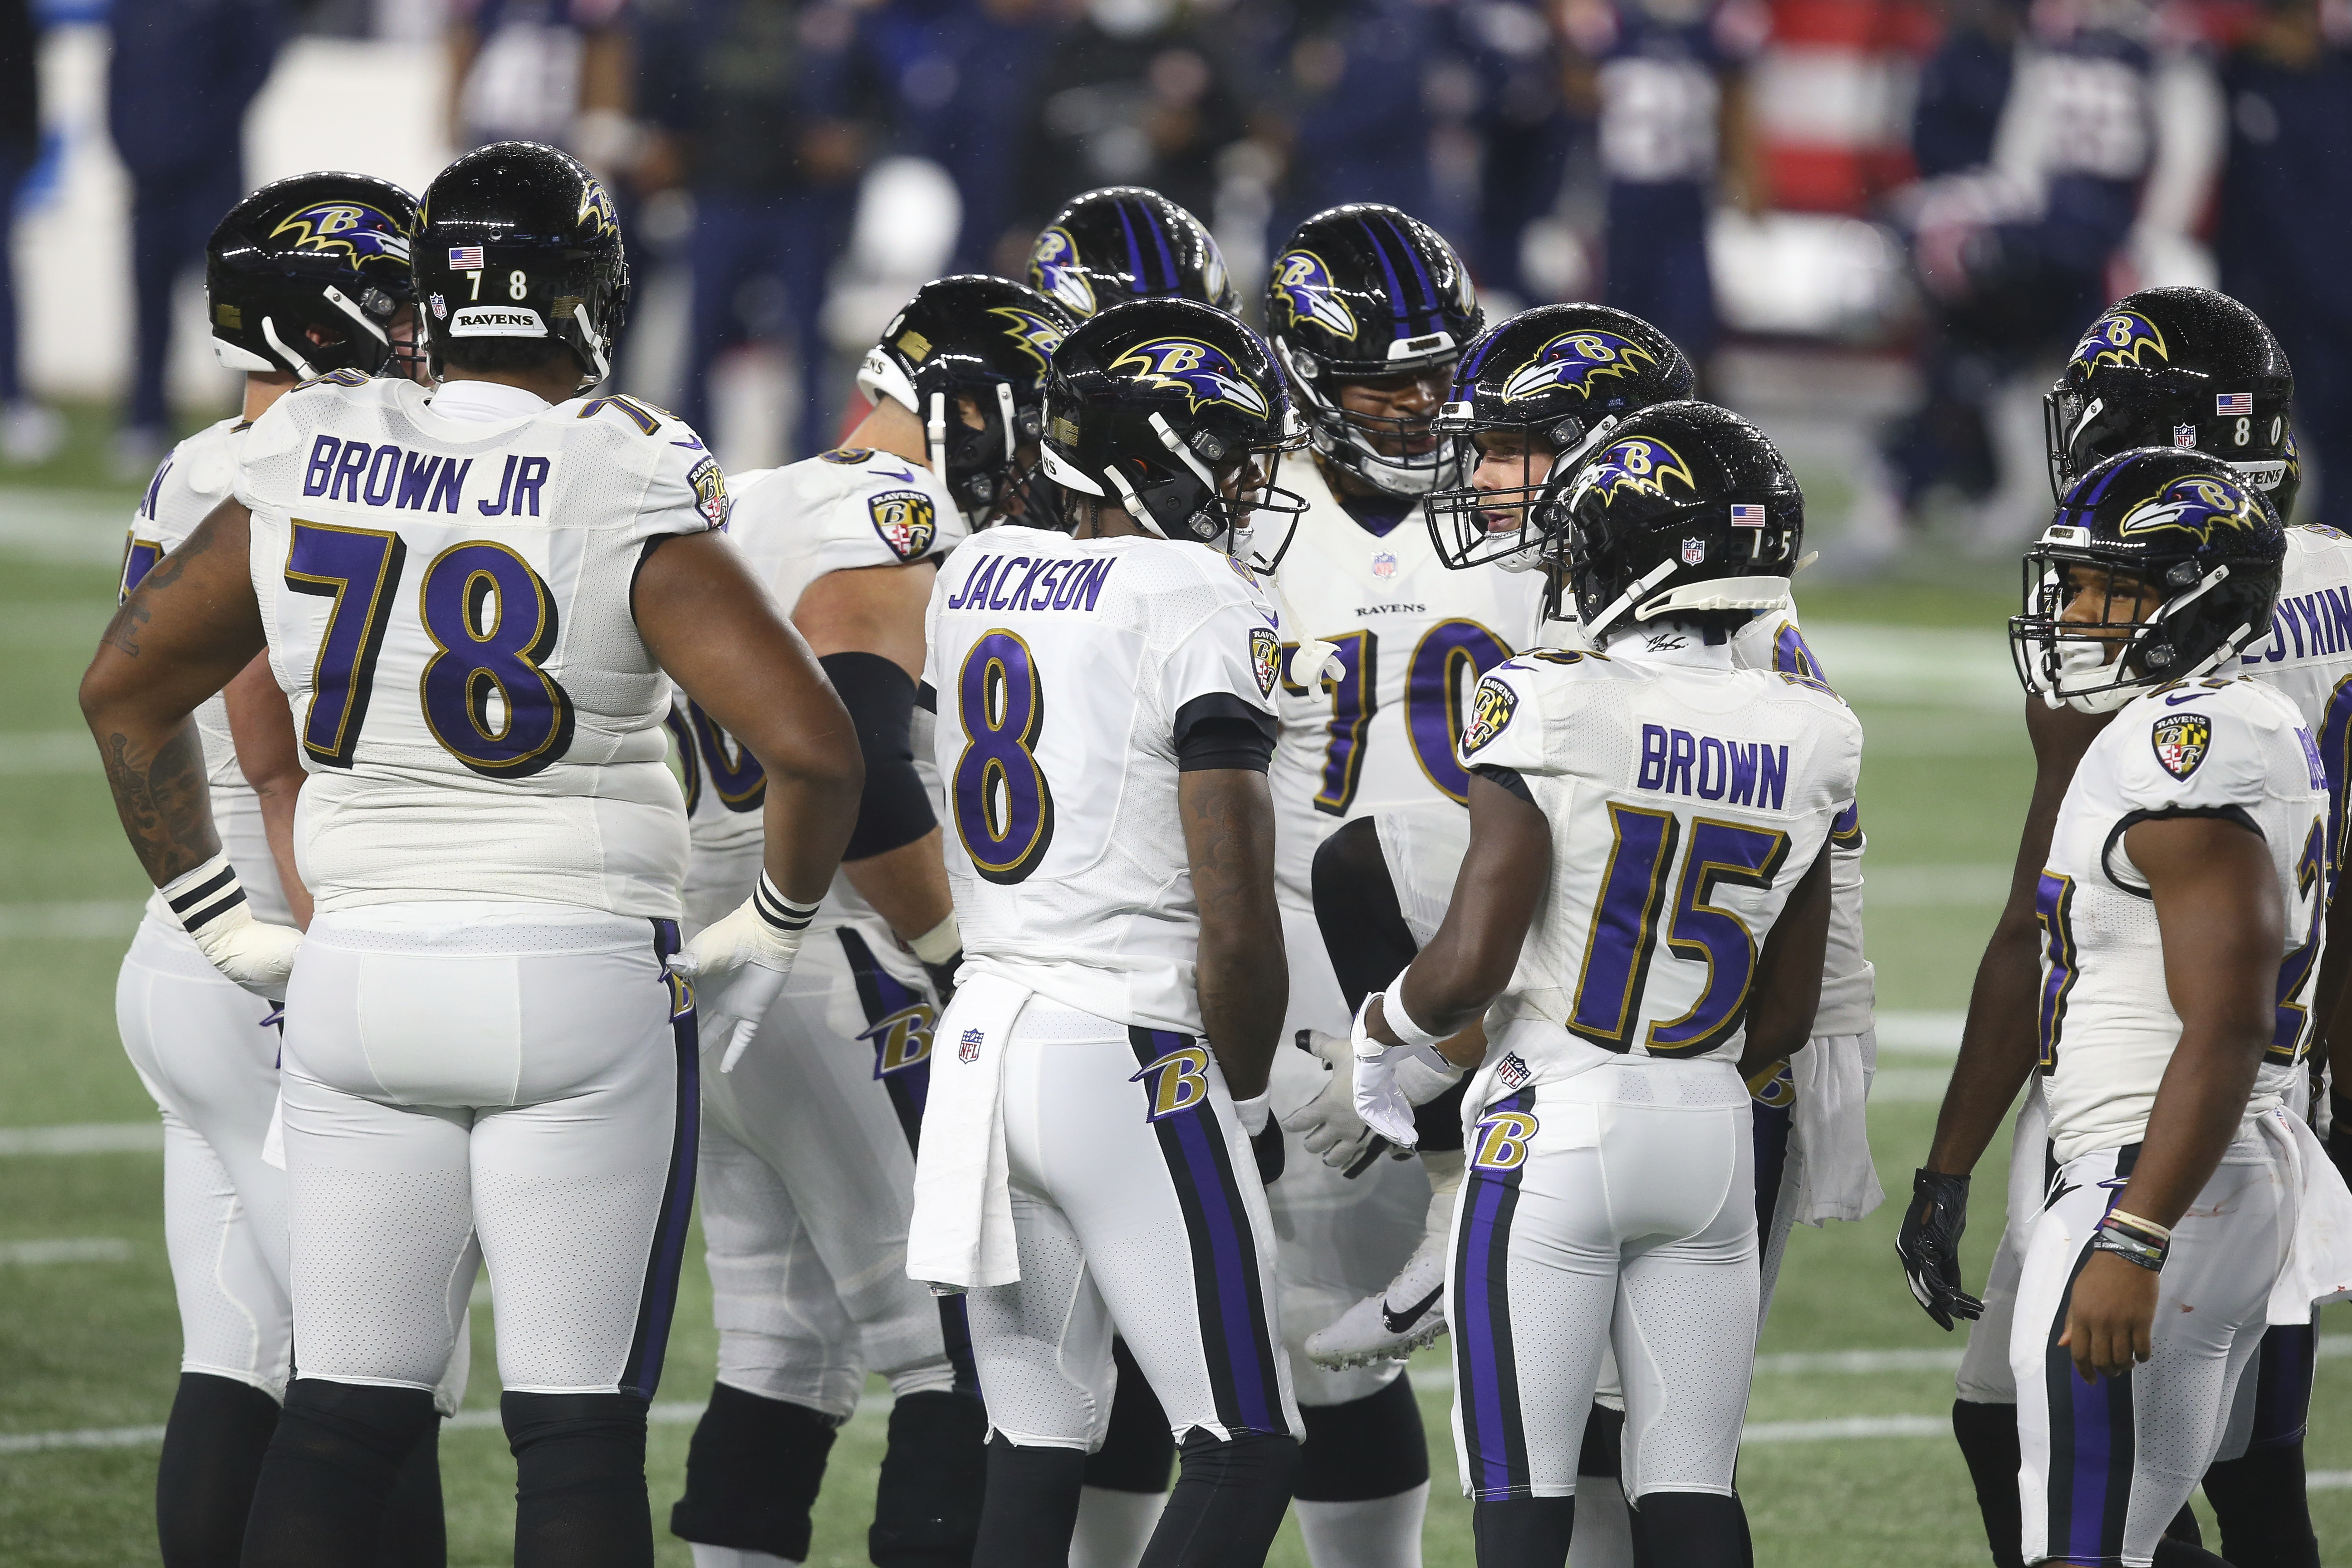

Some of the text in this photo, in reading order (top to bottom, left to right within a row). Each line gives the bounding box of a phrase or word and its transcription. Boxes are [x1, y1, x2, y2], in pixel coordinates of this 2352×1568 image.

[434, 304, 446, 316] NFL
[457, 314, 534, 326] RAVENS
[2177, 435, 2193, 446] NFL
[303, 434, 551, 517] BROWN JR
[690, 458, 718, 483] RAVEN
[872, 492, 929, 505] RAVENS
[1685, 549, 1701, 561] NFL
[949, 554, 1117, 612] JACKSON
[1354, 603, 1426, 617] RAVENS
[284, 518, 575, 780] 78
[1253, 631, 1280, 648] RAVENS
[1483, 679, 1515, 705] RAVENS
[2156, 715, 2206, 729] RAVENS
[952, 627, 1055, 885] 8
[1637, 723, 1789, 810] BROWN
[1565, 799, 1793, 1058] 15
[960, 1043, 978, 1060] NFL
[1499, 1061, 1520, 1087] NFL
